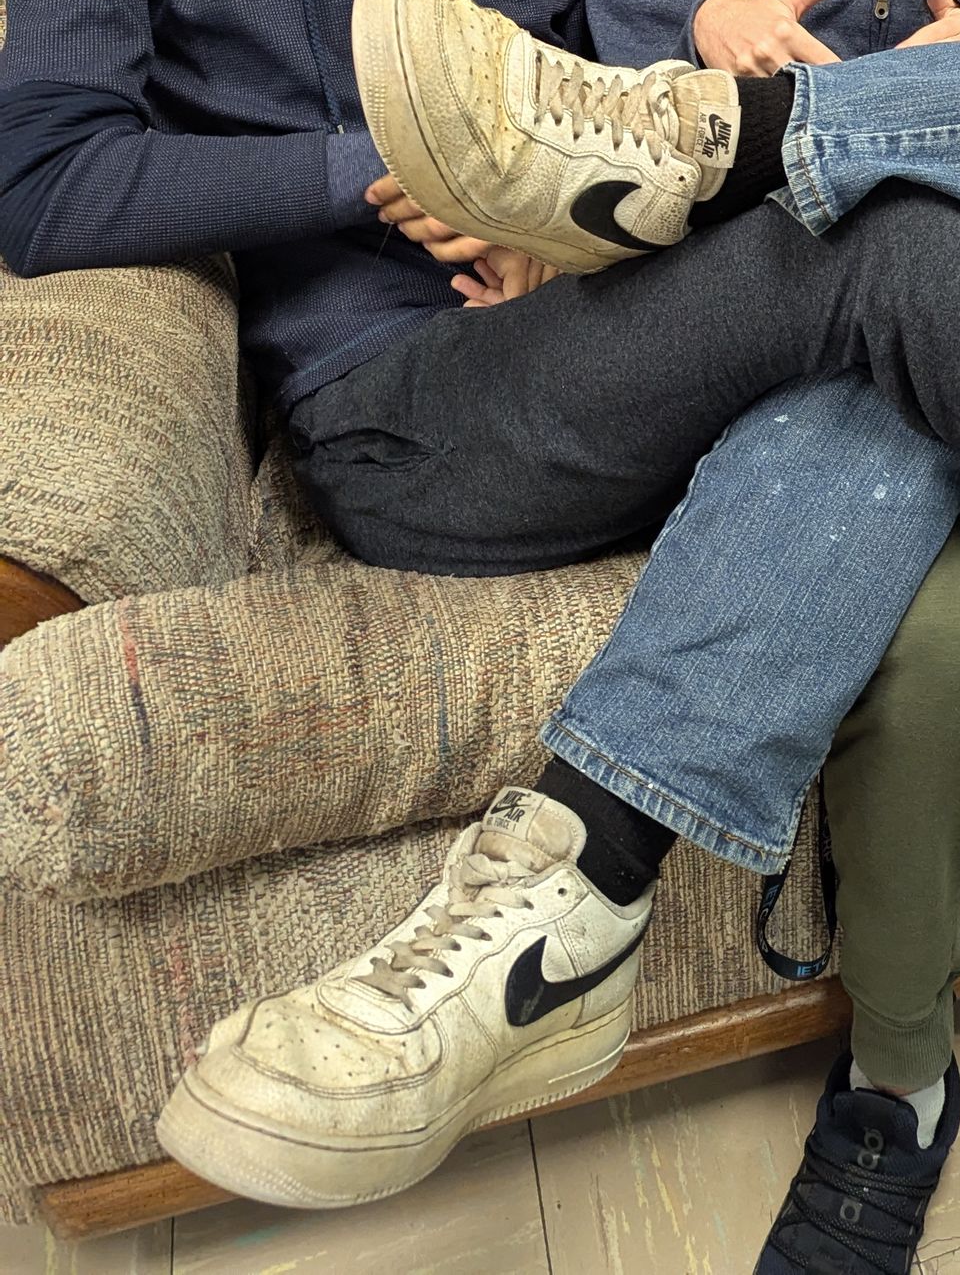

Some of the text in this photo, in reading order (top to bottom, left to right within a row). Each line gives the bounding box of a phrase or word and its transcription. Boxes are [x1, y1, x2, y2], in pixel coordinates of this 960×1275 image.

[717, 120, 732, 150] NIKE
[701, 136, 715, 159] AIR
[503, 807, 525, 823] AIR
